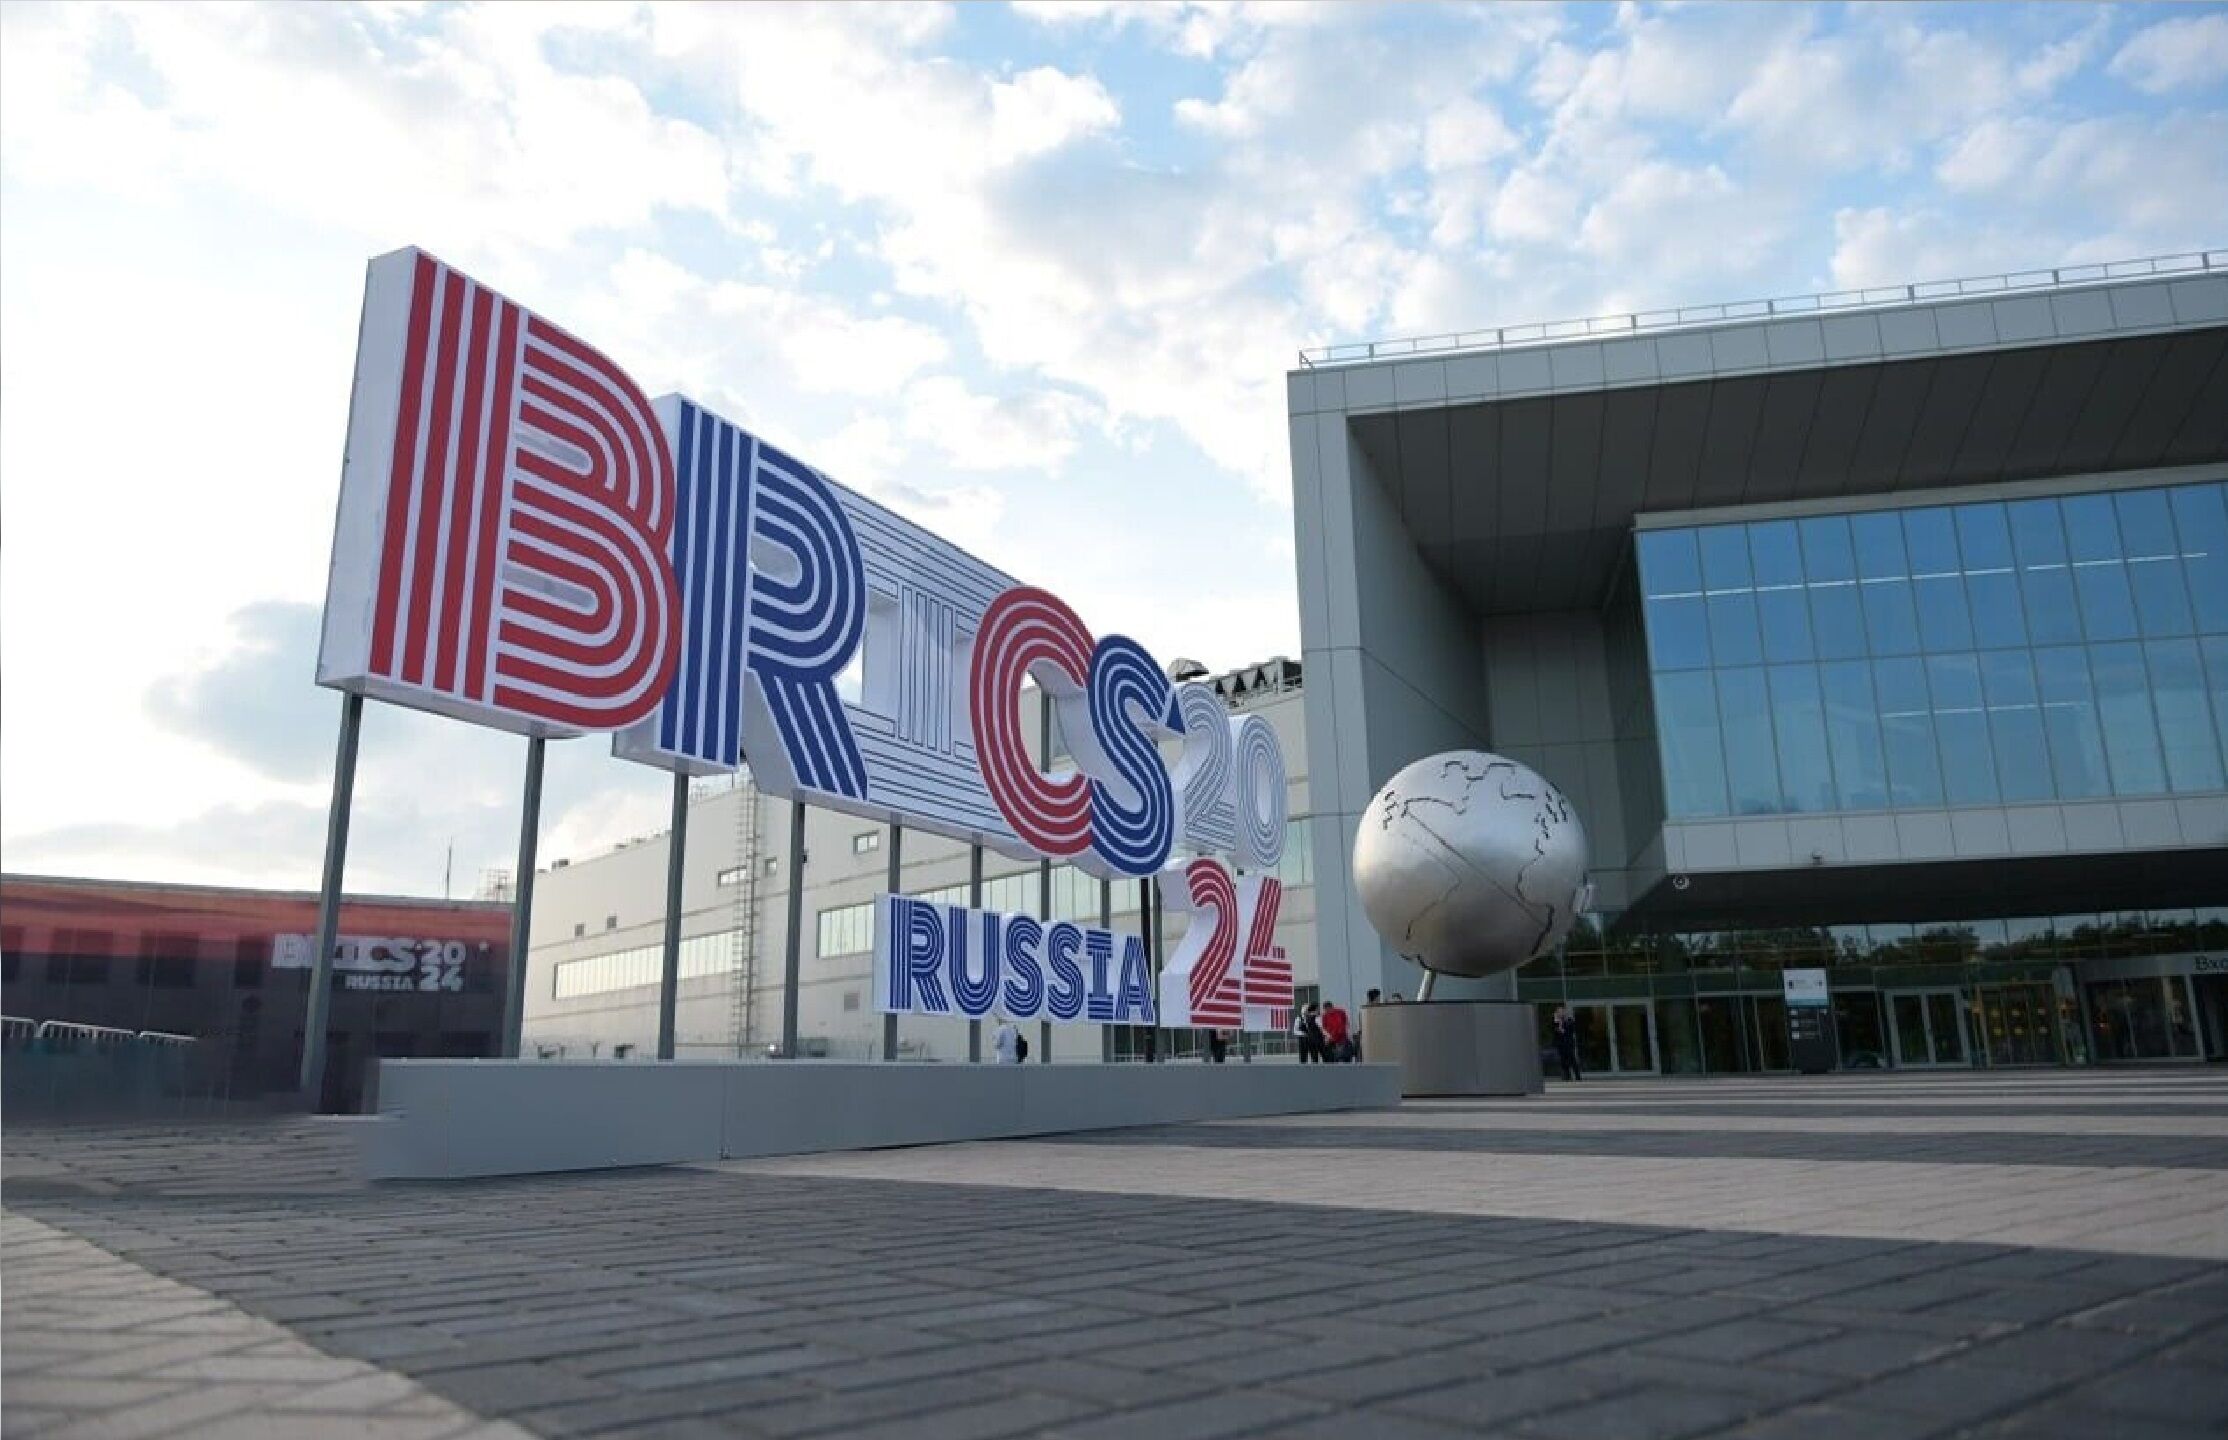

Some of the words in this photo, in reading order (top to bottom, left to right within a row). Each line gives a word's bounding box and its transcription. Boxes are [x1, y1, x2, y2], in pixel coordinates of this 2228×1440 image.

[364, 247, 1176, 877] BRICS
[1181, 682, 1288, 868] 20
[344, 973, 414, 990] RUSSIA
[419, 964, 465, 991] 24
[421, 939, 467, 965] 20
[888, 896, 1155, 1022] RUSSIA
[1185, 857, 1294, 1031] 24
